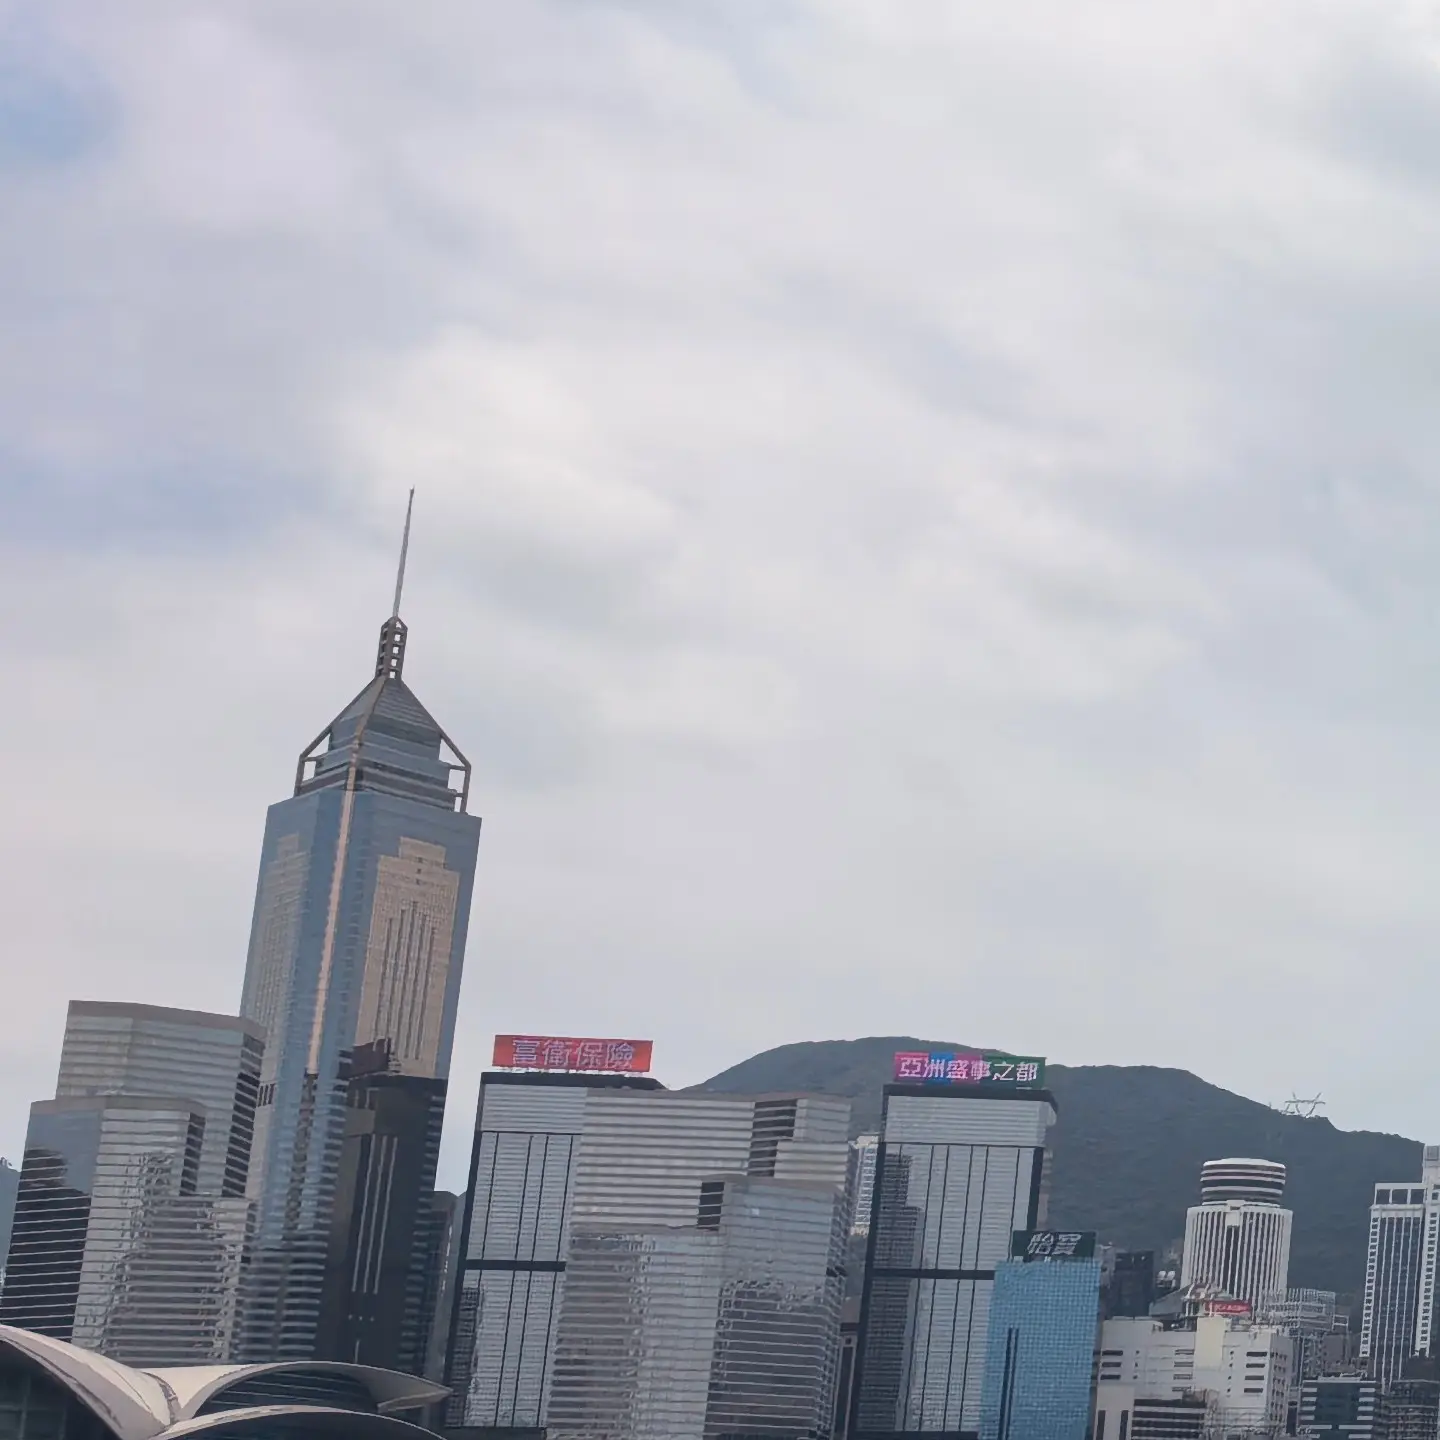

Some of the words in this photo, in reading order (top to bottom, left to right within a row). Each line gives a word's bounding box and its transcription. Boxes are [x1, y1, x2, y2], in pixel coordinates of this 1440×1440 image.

[899, 1057, 1038, 1082] 亞洲盛事之都
